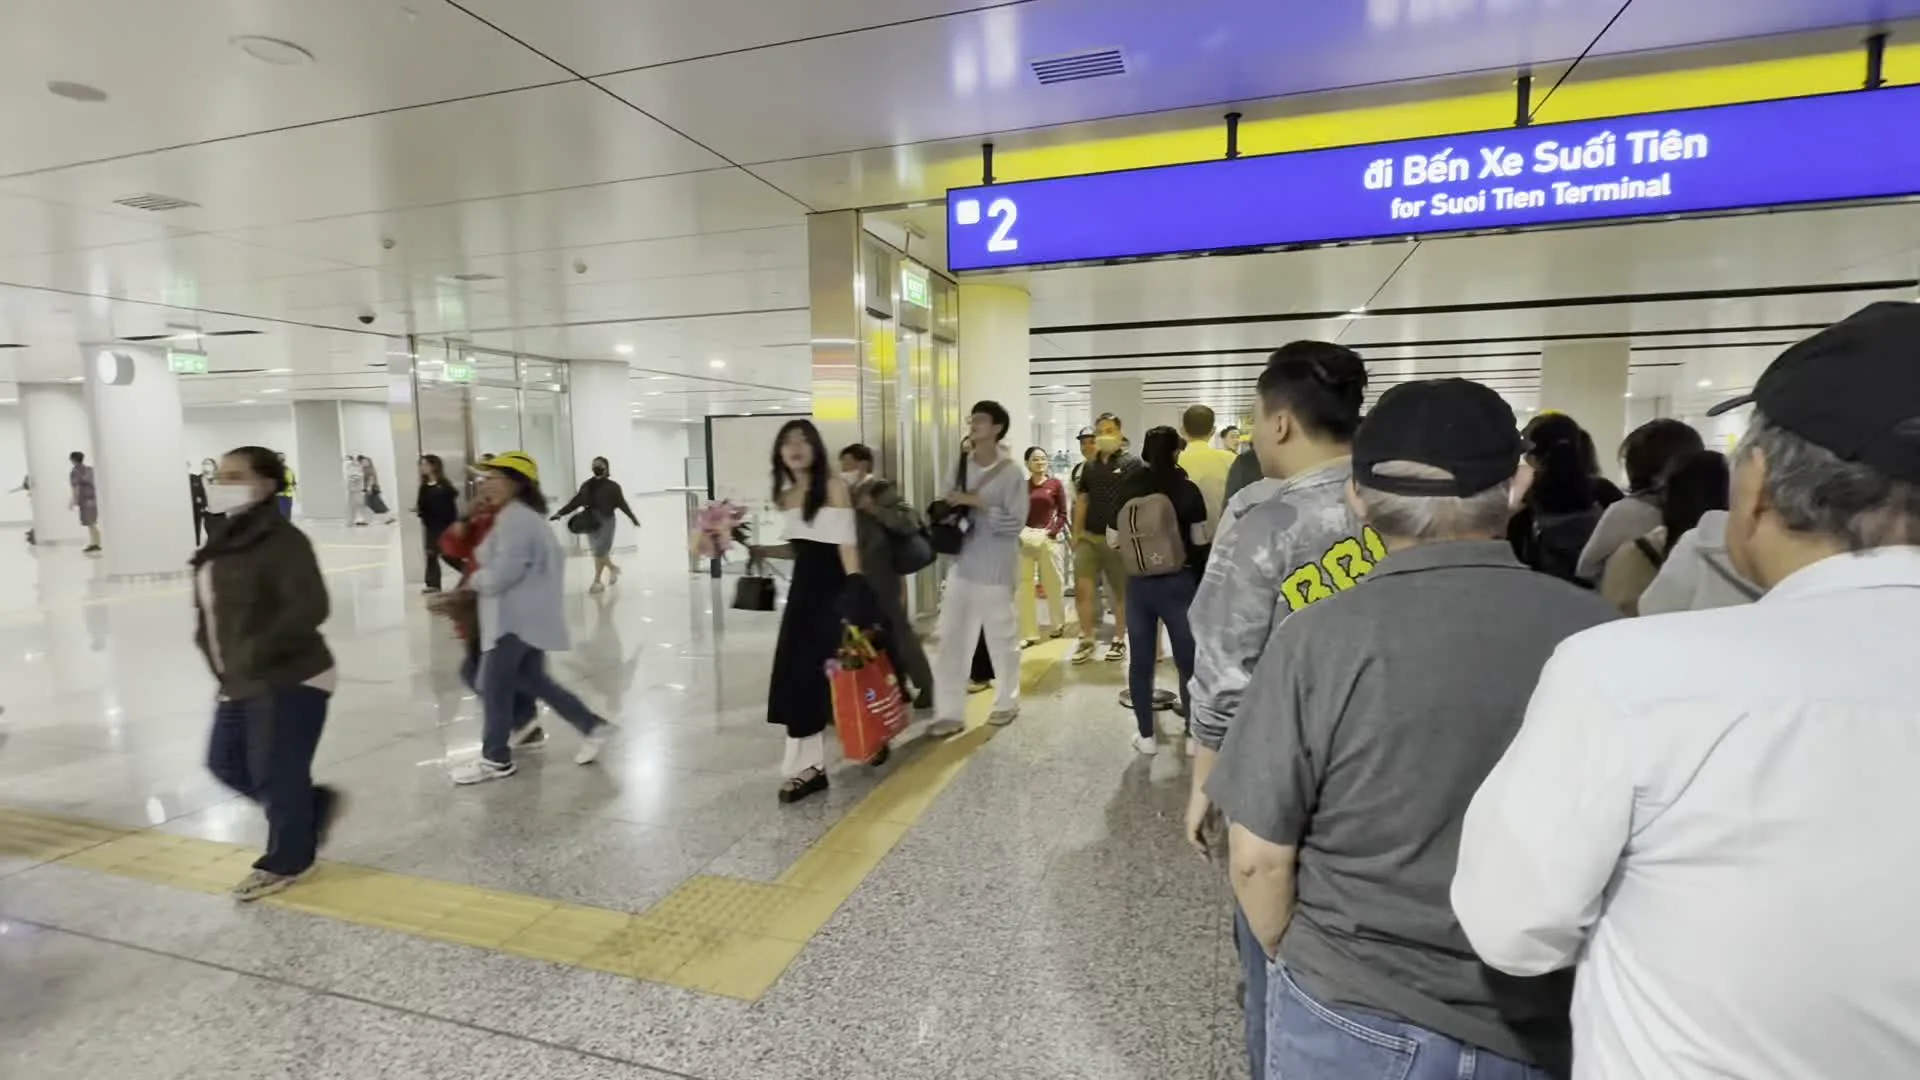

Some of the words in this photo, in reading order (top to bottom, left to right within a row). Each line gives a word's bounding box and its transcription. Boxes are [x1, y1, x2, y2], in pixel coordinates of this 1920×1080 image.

[1363, 158, 1393, 190] đi
[1403, 147, 1470, 187] Bến
[1477, 146, 1525, 179] Xe
[1532, 130, 1617, 174] Suối
[1625, 128, 1708, 165] Tiên
[1390, 197, 1427, 220] for
[1430, 189, 1486, 216] Suoi
[1491, 186, 1546, 211] Tien
[1551, 172, 1672, 206] Terminal
[987, 197, 1019, 253] 2
